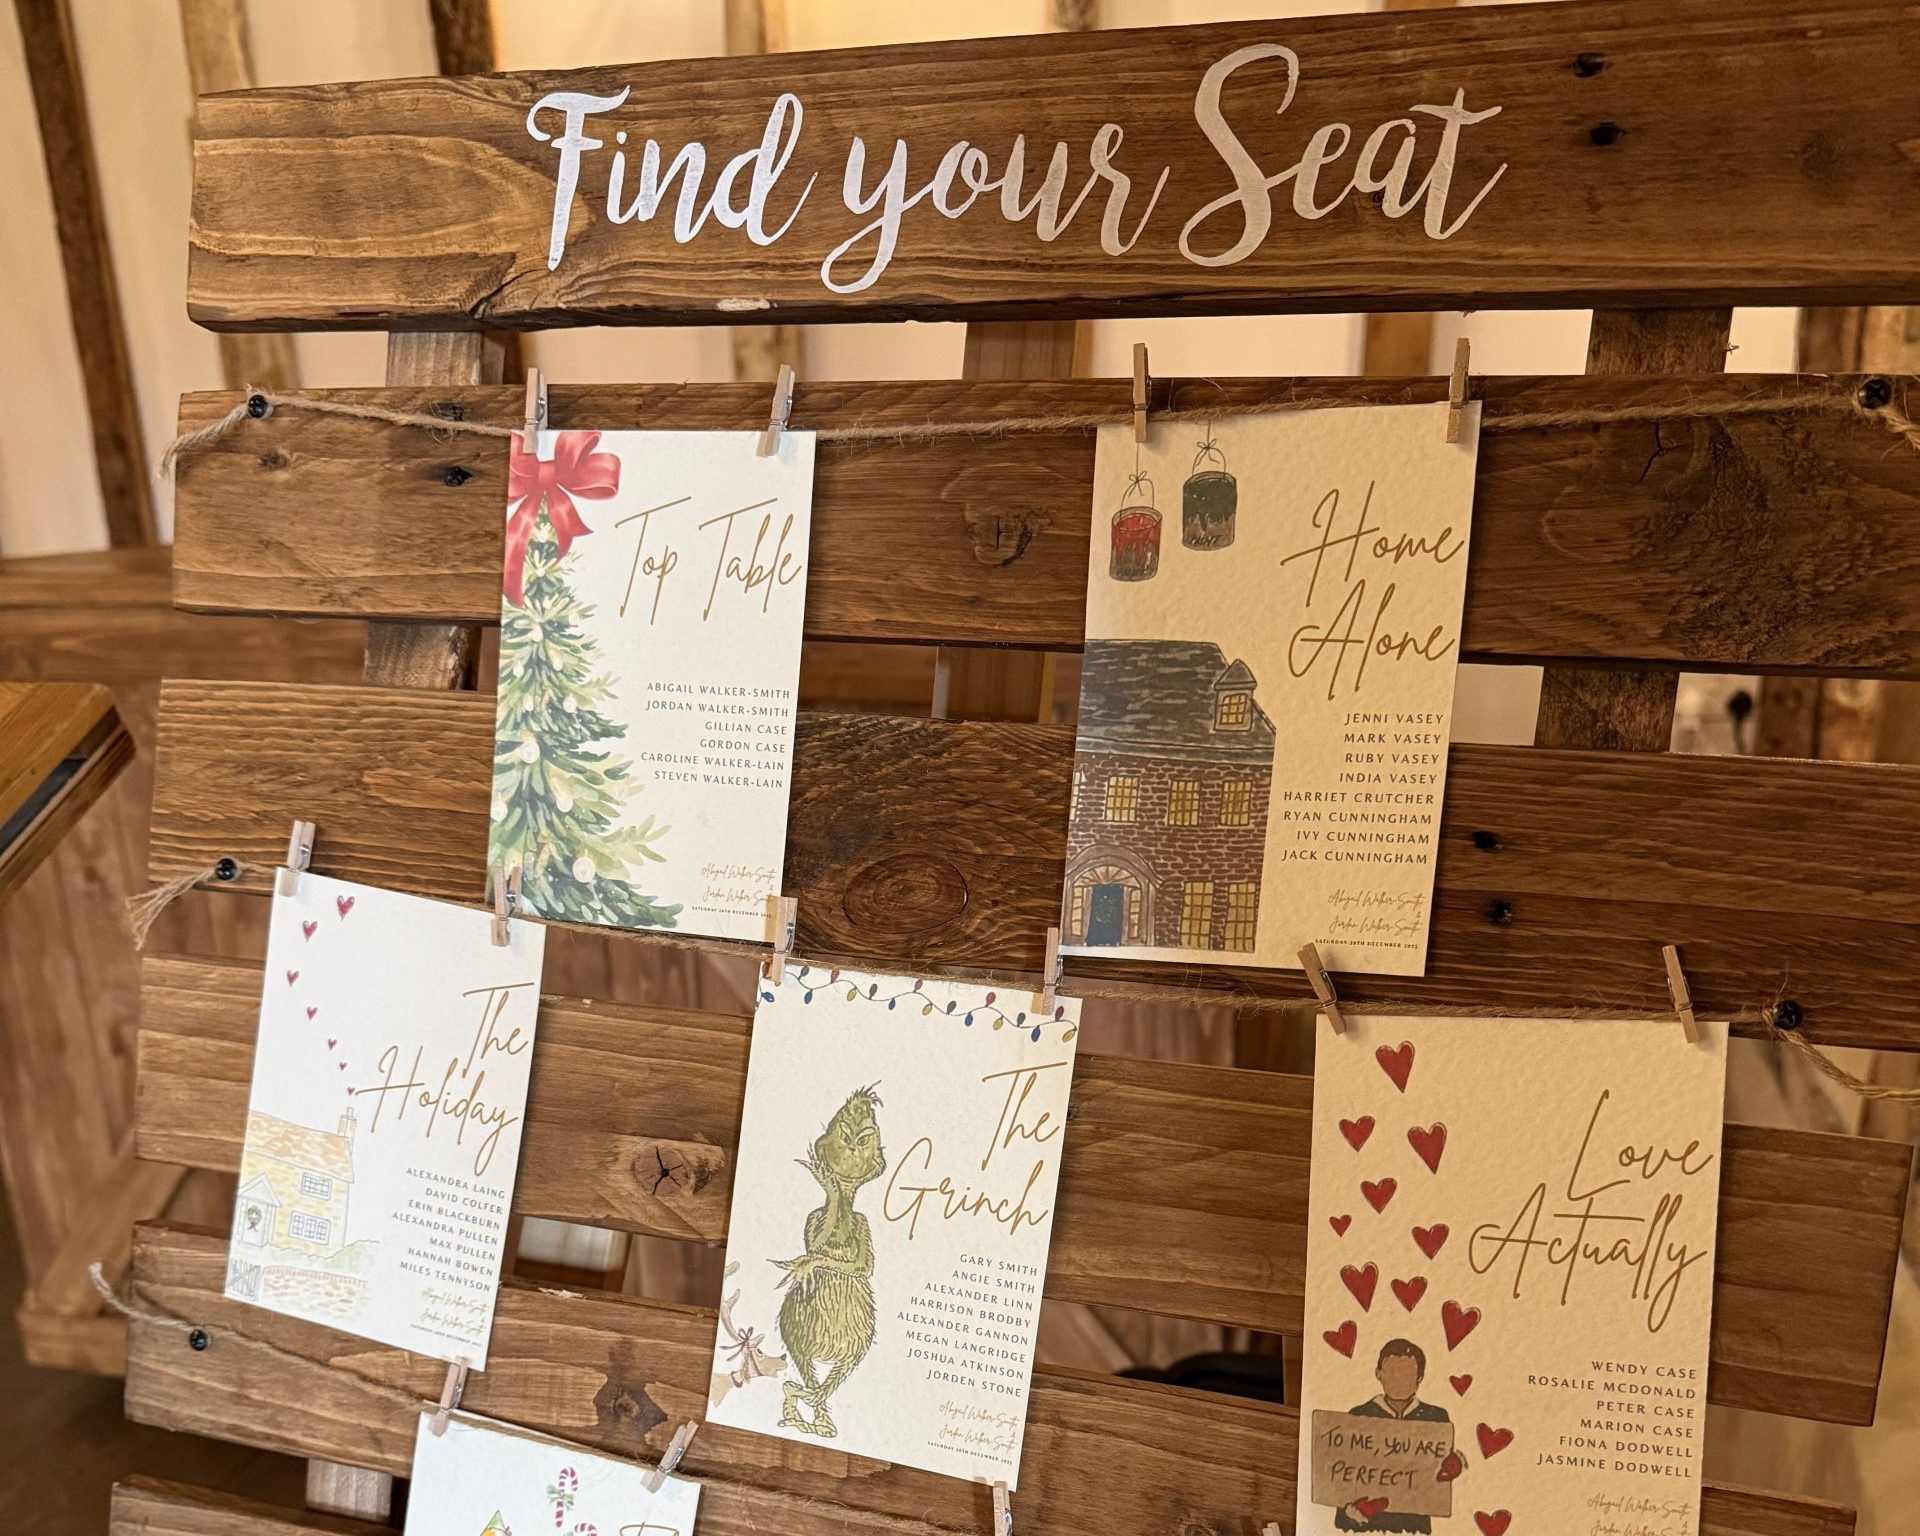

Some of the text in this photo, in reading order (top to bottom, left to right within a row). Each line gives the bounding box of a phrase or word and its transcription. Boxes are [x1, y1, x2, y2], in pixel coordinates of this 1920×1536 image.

[527, 44, 1507, 294] Find your Seat
[1280, 480, 1464, 608] Home
[615, 496, 801, 625] Top Table
[1289, 578, 1456, 701] Alone
[648, 683, 790, 699] ABIGAIL WALKER-SMITH
[645, 700, 788, 717] JORDAN WALKER-SMITH
[1344, 713, 1444, 725] JENNI VASEY
[705, 722, 787, 735] GILLIAN CASE
[1344, 734, 1442, 744] MARK VASEY
[700, 739, 785, 753] GORDON CASE
[1345, 753, 1440, 764] RUBY VASEY
[641, 752, 784, 770] CAROLINE WALKER-LAIN
[655, 771, 783, 788] STEVEN WALKER-LAIN
[1340, 773, 1437, 784] INDIA VASEY
[1284, 791, 1434, 804] HARRIET CRUTCHER
[1284, 811, 1431, 824] RYAN CUNNINGHAM
[1297, 831, 1429, 844] IVY CUNNINGHAM
[1281, 850, 1427, 864] JACK CUNNINGHAM
[463, 982, 535, 1079] The
[355, 1045, 520, 1176] Holiday
[981, 1062, 1068, 1170] The
[1567, 1089, 1714, 1201] Love
[406, 1167, 505, 1199] ALEXANDRA LAING
[883, 1137, 1049, 1240] Grinch
[408, 1200, 500, 1230] ERIN BLACKBURN
[426, 1188, 503, 1215] DAVID COLFER
[392, 1212, 498, 1245] ALEXANDRA PULLEN
[408, 1248, 493, 1277] HANNAH BOWEN
[430, 1237, 496, 1261] MAX PULLEN
[1468, 1183, 1708, 1333] Actually
[400, 1261, 491, 1292] MILES TENNYSON
[960, 1254, 1037, 1277] GARY SMITH
[952, 1270, 1035, 1294] ANGIE SMITH
[925, 1282, 1033, 1311] ALEXANDER LINN
[911, 1296, 1031, 1328] HARRISON BRODBY
[898, 1312, 1029, 1345] ALEXANDER GANNON
[905, 1330, 1026, 1363] MEGAN LANGRIDGE
[907, 1348, 1024, 1380] JOSHUA ATKINSON
[1592, 1361, 1697, 1379] WENDY CASE
[926, 1369, 1022, 1397] JORDEN STONE
[1528, 1375, 1696, 1399] ROSALIE MCDONALD
[1596, 1400, 1694, 1419] PETER CASE
[1321, 1425, 1446, 1458] TO ME, YOU ARE
[1580, 1418, 1693, 1438] MARION CASE
[1559, 1436, 1693, 1458] FIONA DODWELL
[1331, 1460, 1418, 1488] PERFECT
[1537, 1454, 1691, 1478] JASMINE DODWELL
